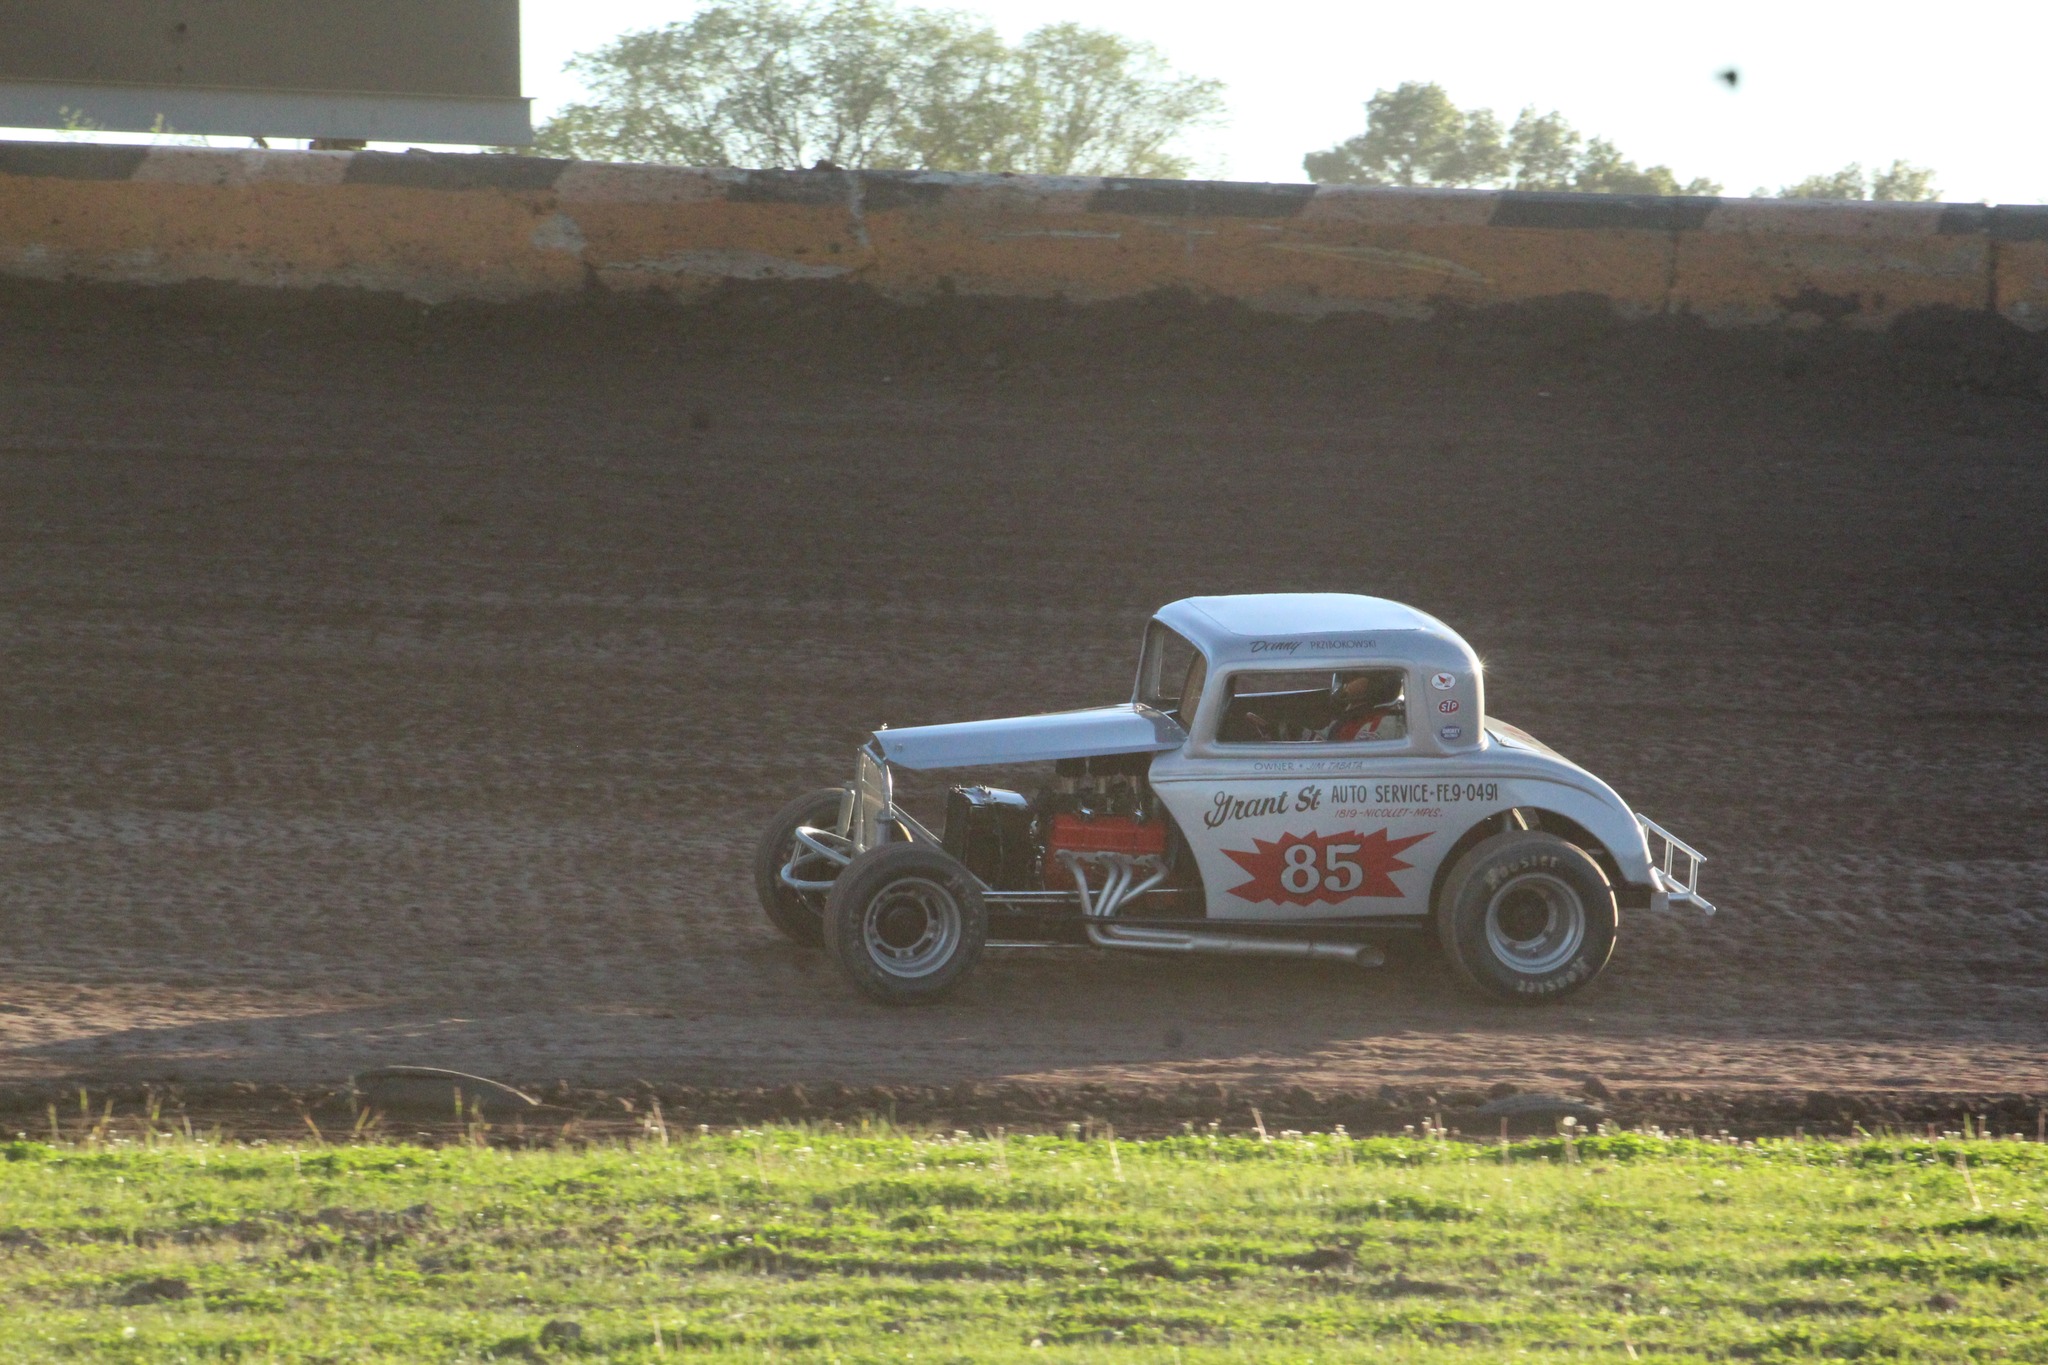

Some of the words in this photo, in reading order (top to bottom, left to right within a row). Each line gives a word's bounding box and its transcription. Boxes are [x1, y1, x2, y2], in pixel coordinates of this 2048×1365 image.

[1440, 700, 1458, 712] STP
[1254, 762, 1294, 771] OWNER
[1204, 790, 1289, 830] Grant
[1331, 785, 1367, 803] AUTO
[1280, 843, 1363, 894] 85
